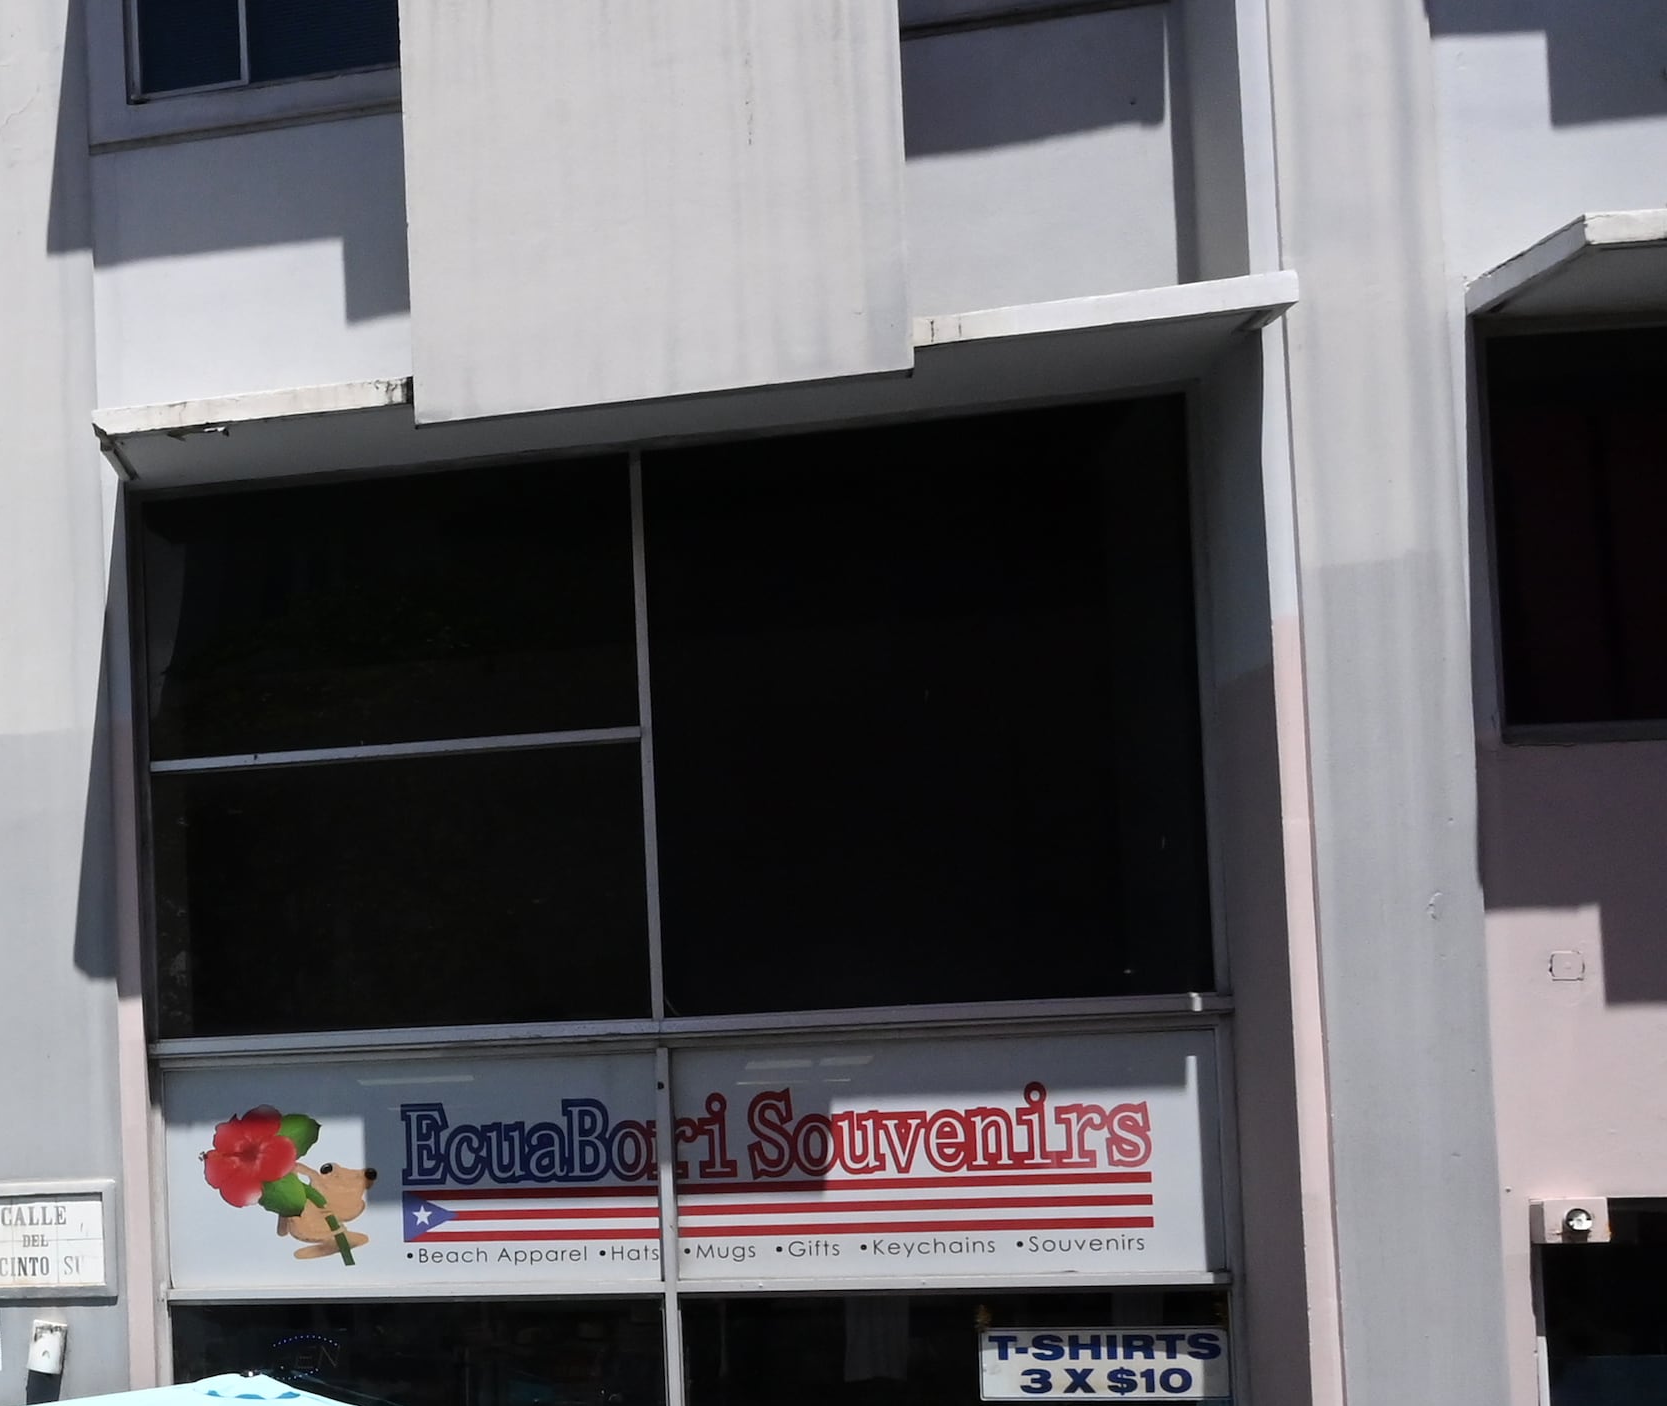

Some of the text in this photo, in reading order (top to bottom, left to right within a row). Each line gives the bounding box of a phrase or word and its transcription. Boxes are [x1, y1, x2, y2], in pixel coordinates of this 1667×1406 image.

[400, 1082, 1151, 1187] EcuaBori Souvenirs
[1, 1205, 67, 1227] CALLE
[22, 1234, 49, 1248] DEL
[419, 1234, 1146, 1267] Beach Apparel Hats Mugs Gifts Keychains Souvenirs
[988, 1333, 1222, 1361] T-SHIRTS
[1020, 1366, 1193, 1395] 3 X $10
